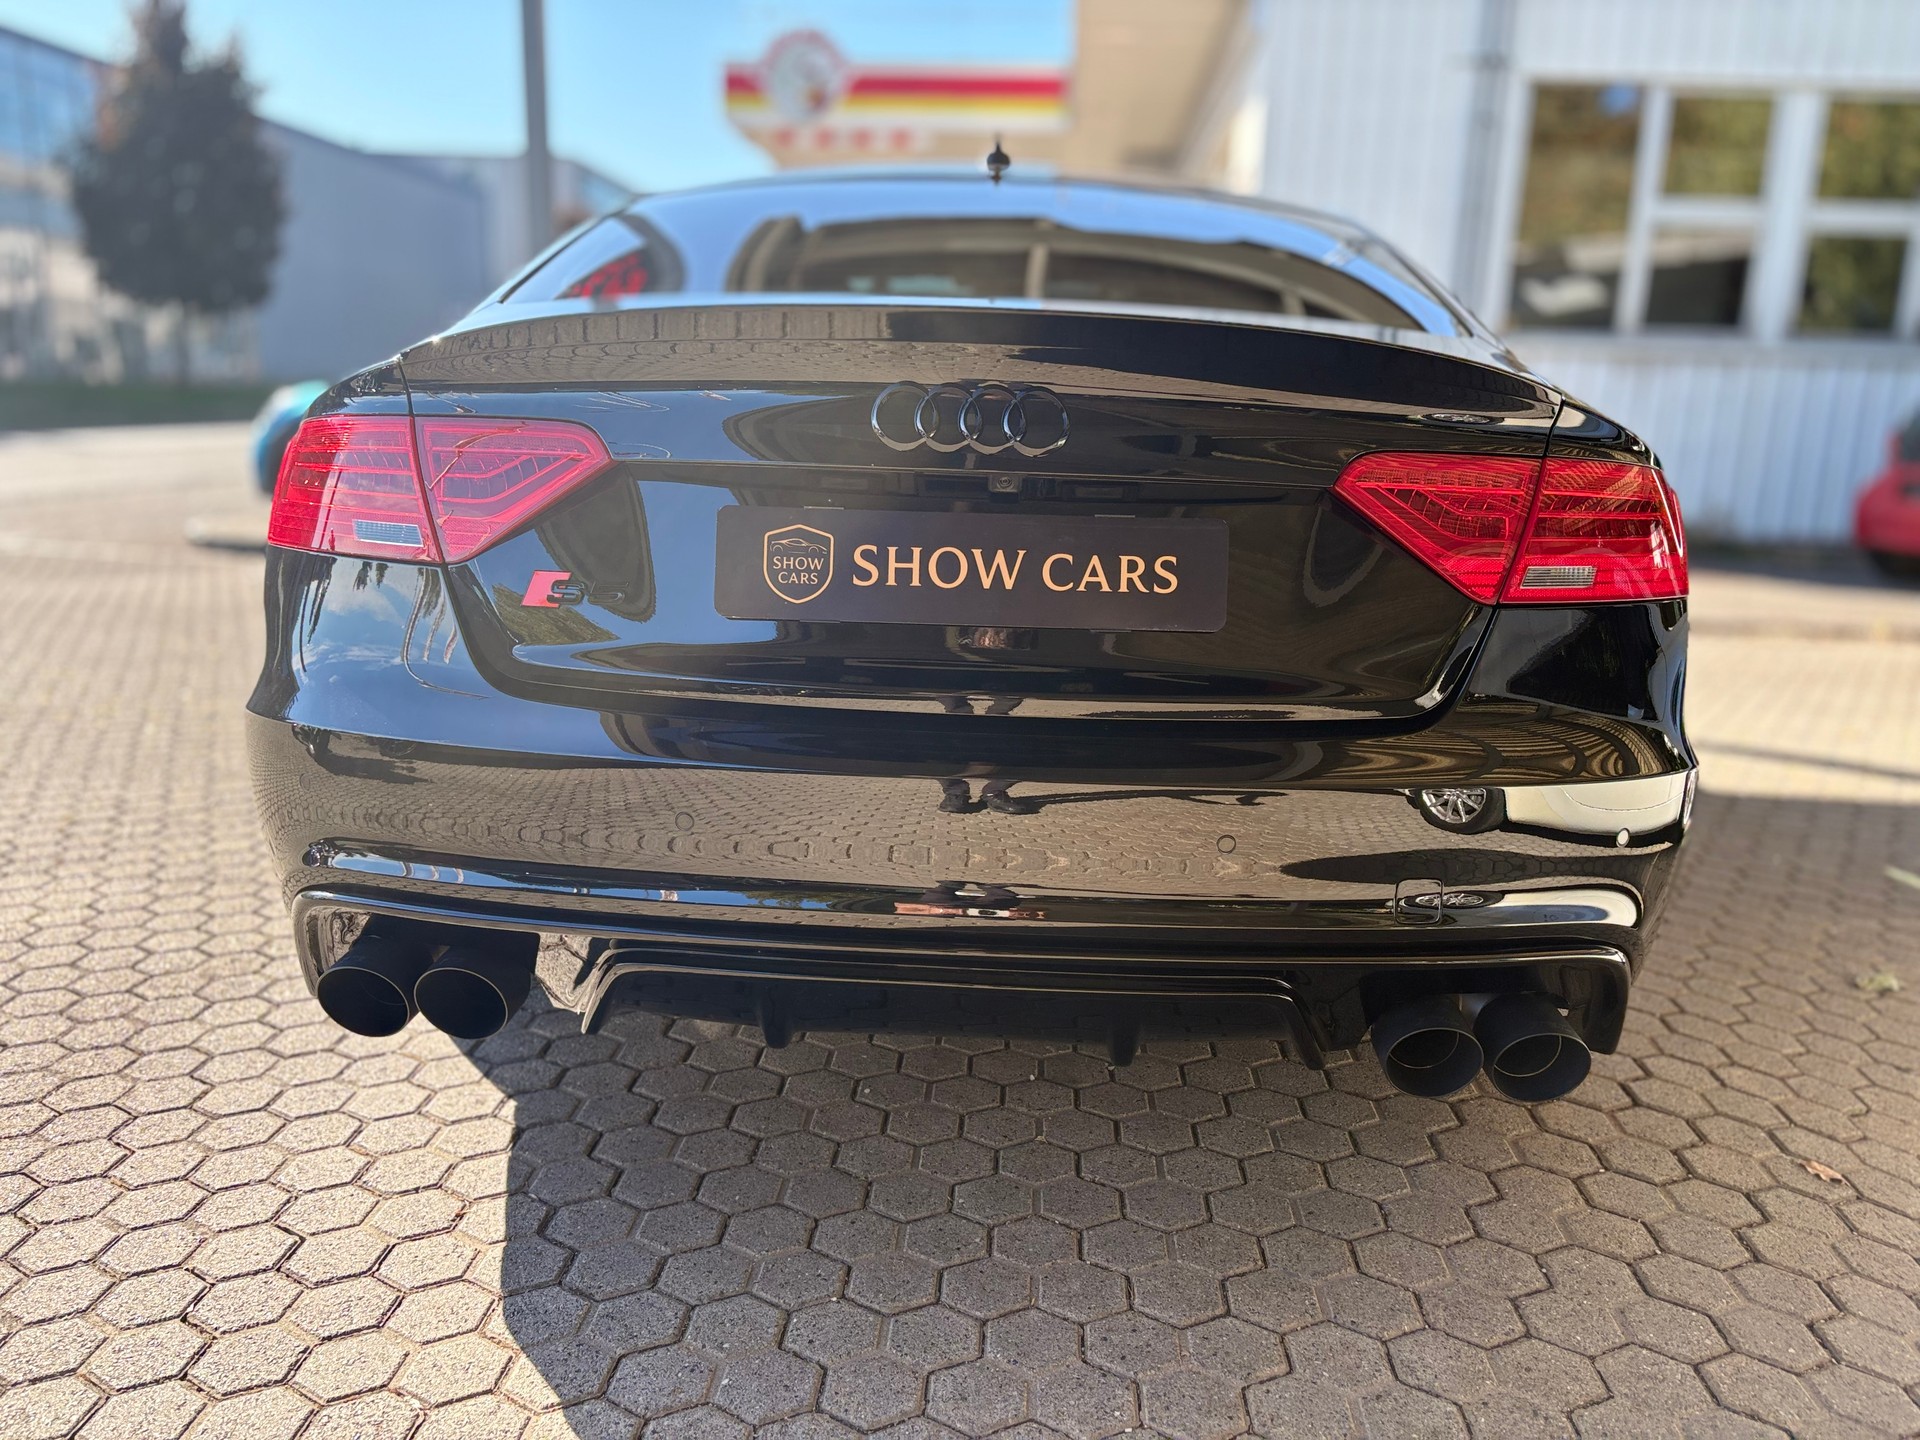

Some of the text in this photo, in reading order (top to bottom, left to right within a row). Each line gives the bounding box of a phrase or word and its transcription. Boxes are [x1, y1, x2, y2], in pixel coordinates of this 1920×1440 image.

[772, 555, 825, 571] SHOW
[852, 543, 1179, 595] SHOW CARS
[778, 571, 819, 585] CARS
